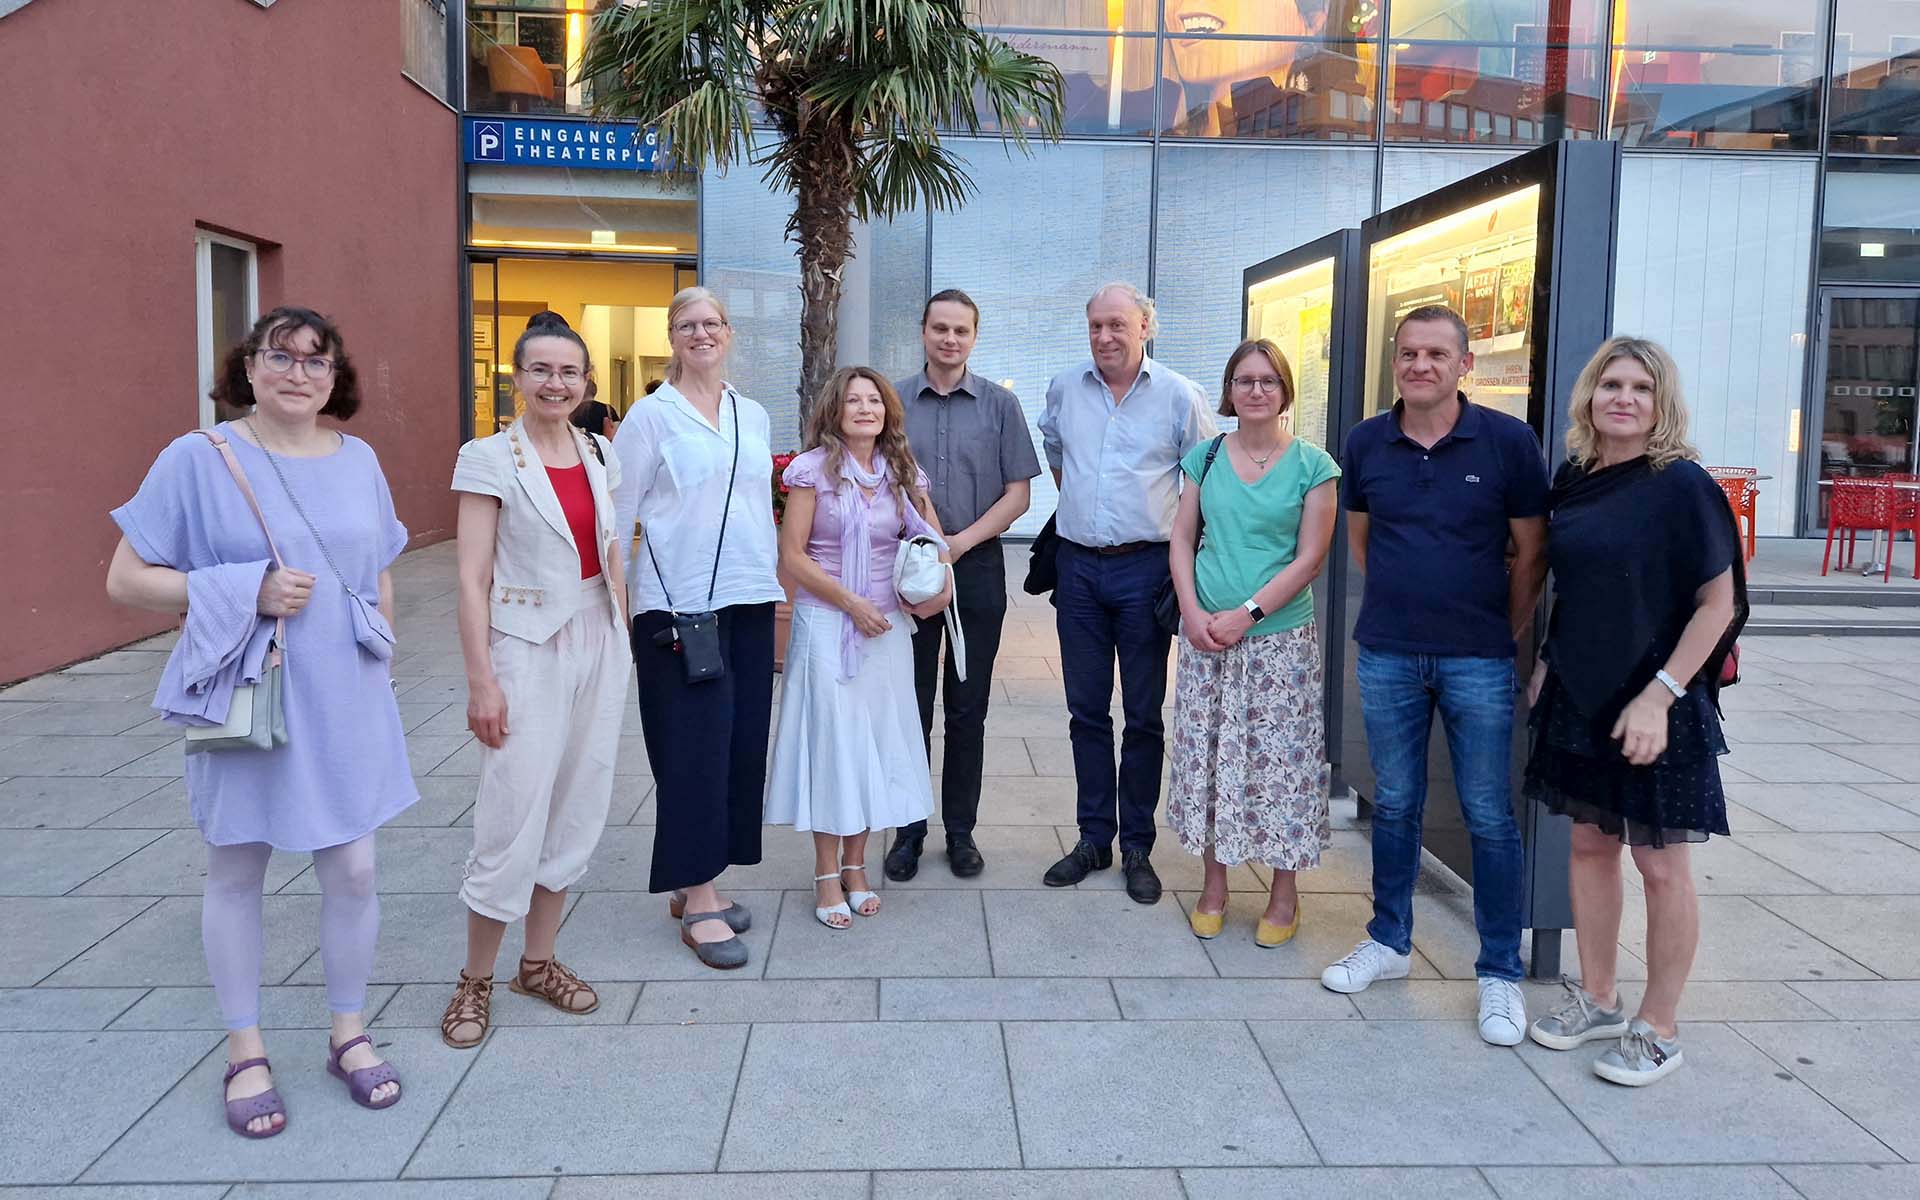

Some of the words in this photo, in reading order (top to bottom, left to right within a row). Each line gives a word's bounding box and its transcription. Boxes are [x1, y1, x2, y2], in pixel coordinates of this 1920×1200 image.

[514, 127, 616, 144] EINGANG
[481, 134, 499, 157] P
[514, 144, 671, 163] THEATERPLA
